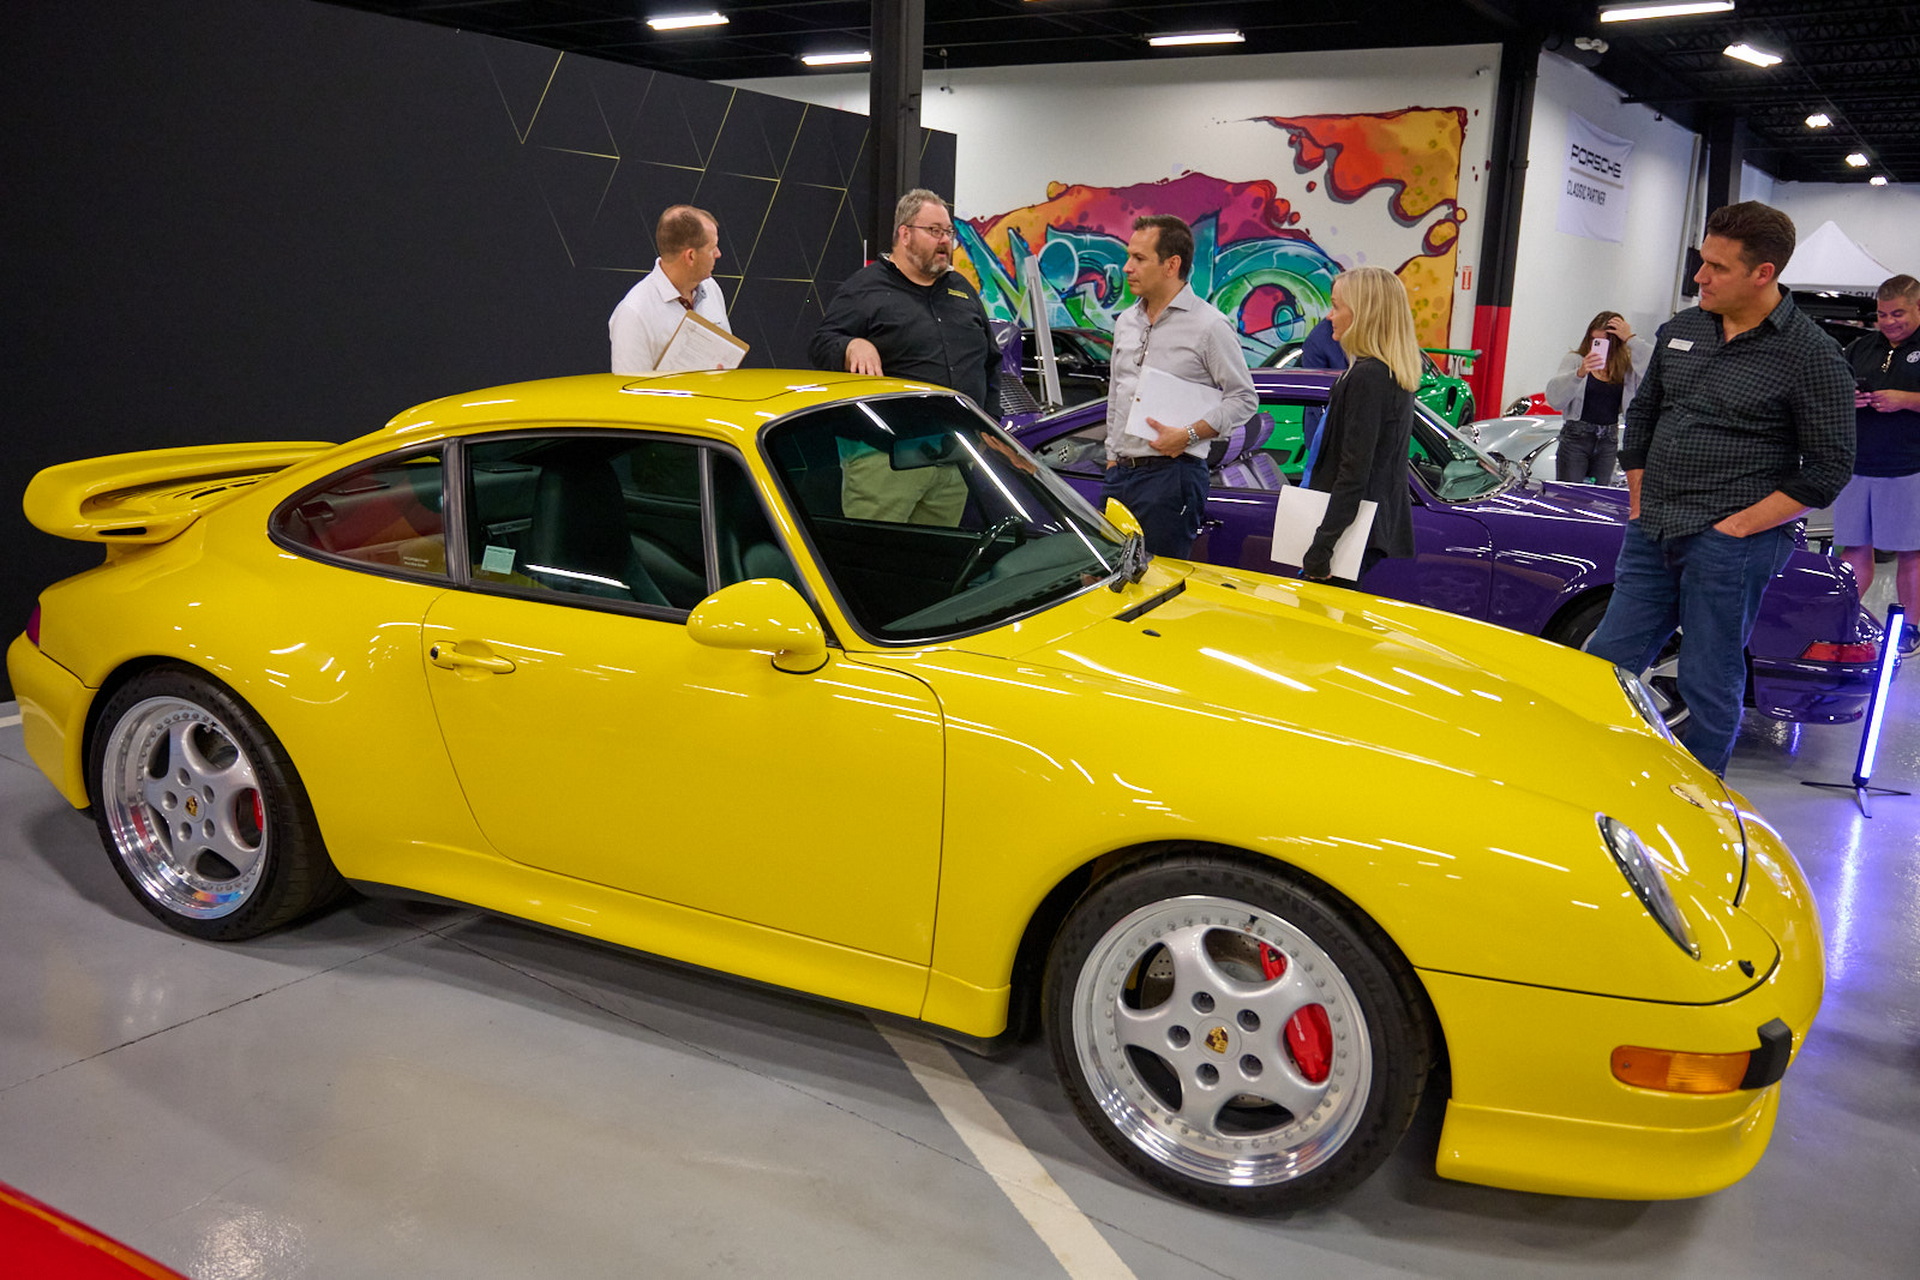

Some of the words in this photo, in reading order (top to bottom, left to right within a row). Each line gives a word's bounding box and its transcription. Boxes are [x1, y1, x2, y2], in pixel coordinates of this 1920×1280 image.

[1571, 143, 1621, 178] PORSCHE
[1566, 180, 1587, 200] CLASSIC
[1586, 186, 1606, 205] PARTNER
